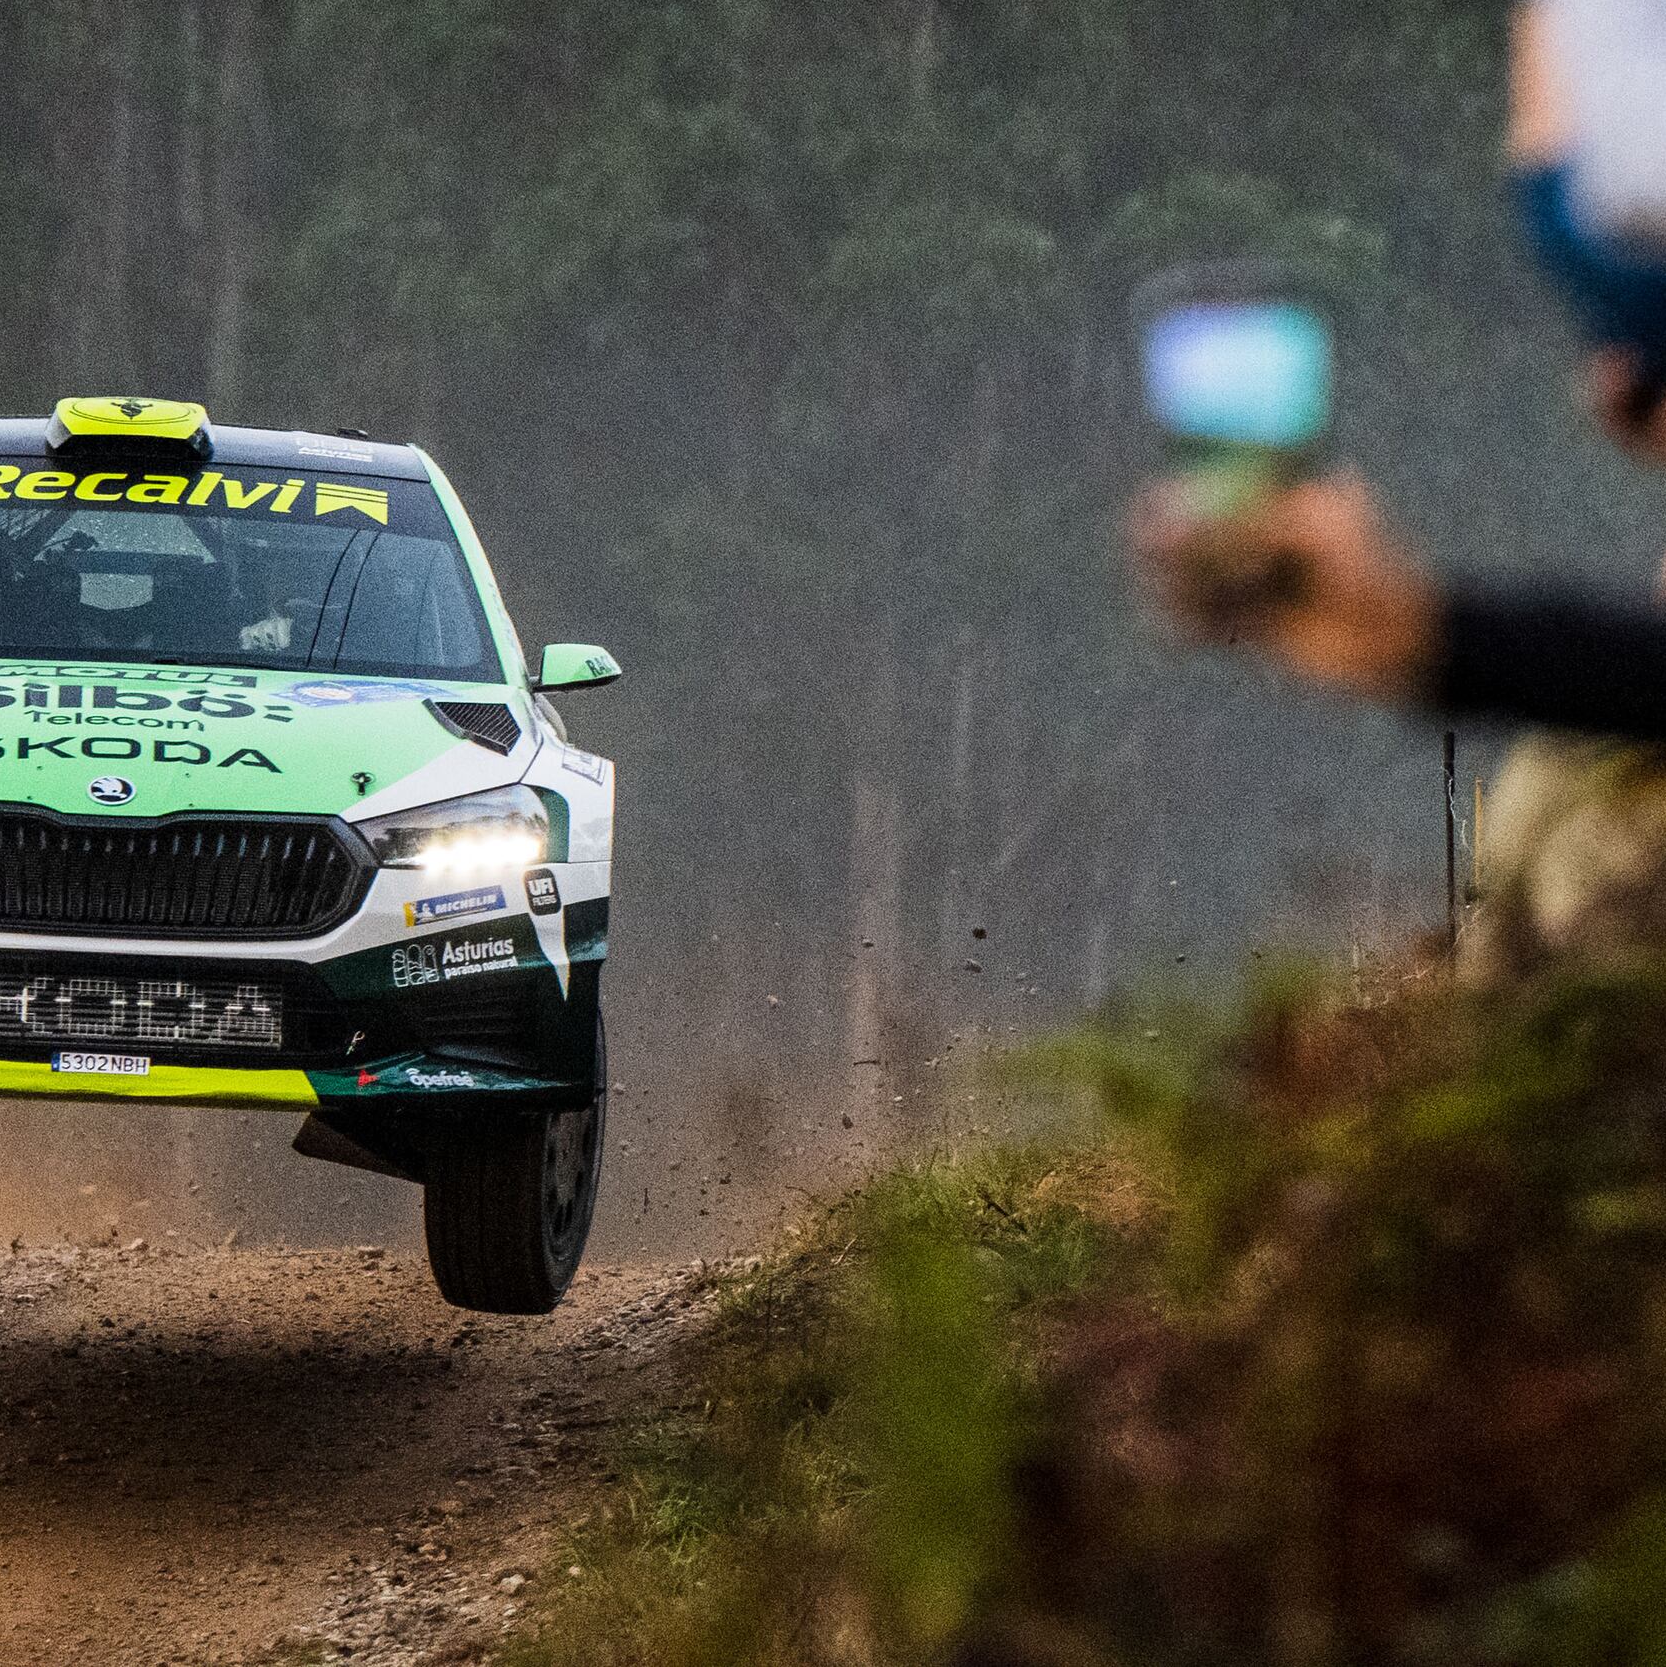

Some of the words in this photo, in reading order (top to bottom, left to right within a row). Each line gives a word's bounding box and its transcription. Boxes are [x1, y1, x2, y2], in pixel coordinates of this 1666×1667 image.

[24, 710, 206, 732] Telecom
[435, 895, 497, 915] MICHELIN
[442, 938, 515, 966] Asturias
[483, 956, 519, 974] natural
